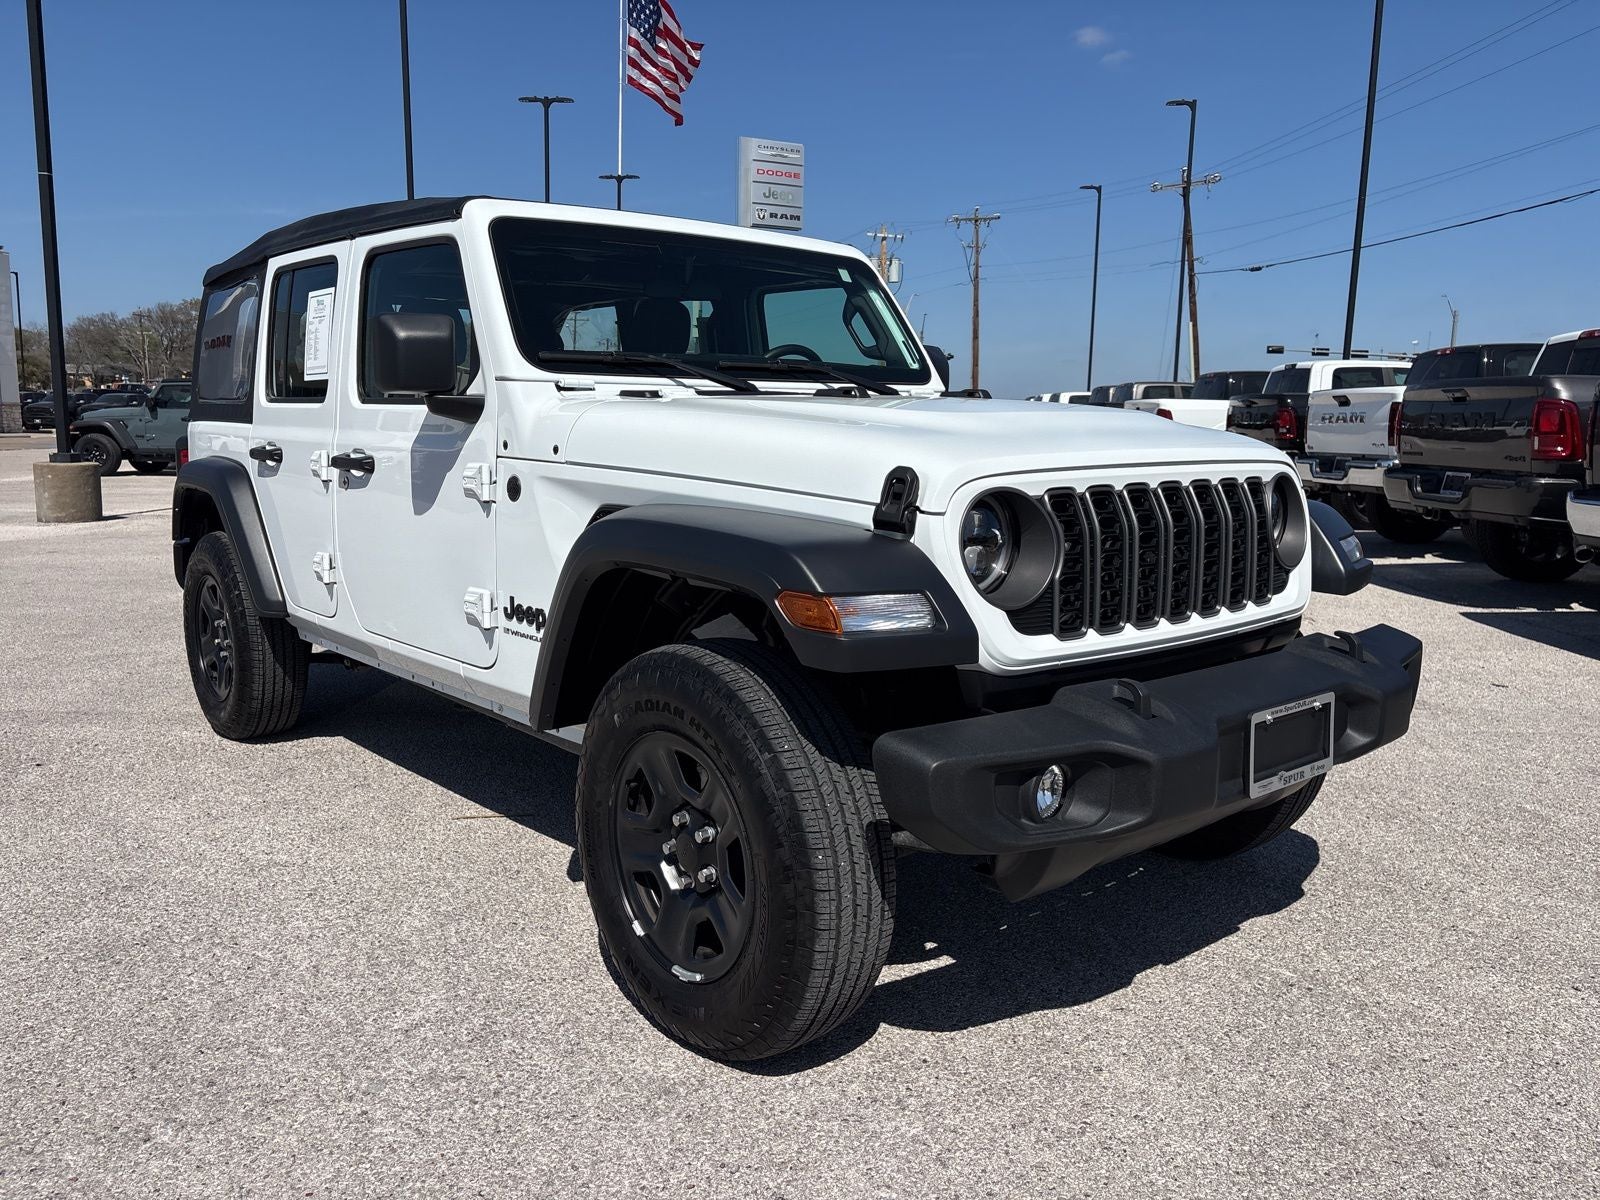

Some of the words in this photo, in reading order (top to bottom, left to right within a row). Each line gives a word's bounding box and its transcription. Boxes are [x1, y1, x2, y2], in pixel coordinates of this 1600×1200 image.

[757, 144, 801, 154] CHRYSLER
[756, 168, 801, 180] DODGE
[762, 186, 793, 204] Jeep
[769, 212, 801, 222] RAM
[1321, 411, 1367, 425] RAM
[1423, 411, 1497, 430] RAM
[503, 595, 547, 633] Jeep
[510, 628, 543, 643] WRANGL
[1283, 771, 1305, 785] SPUR
